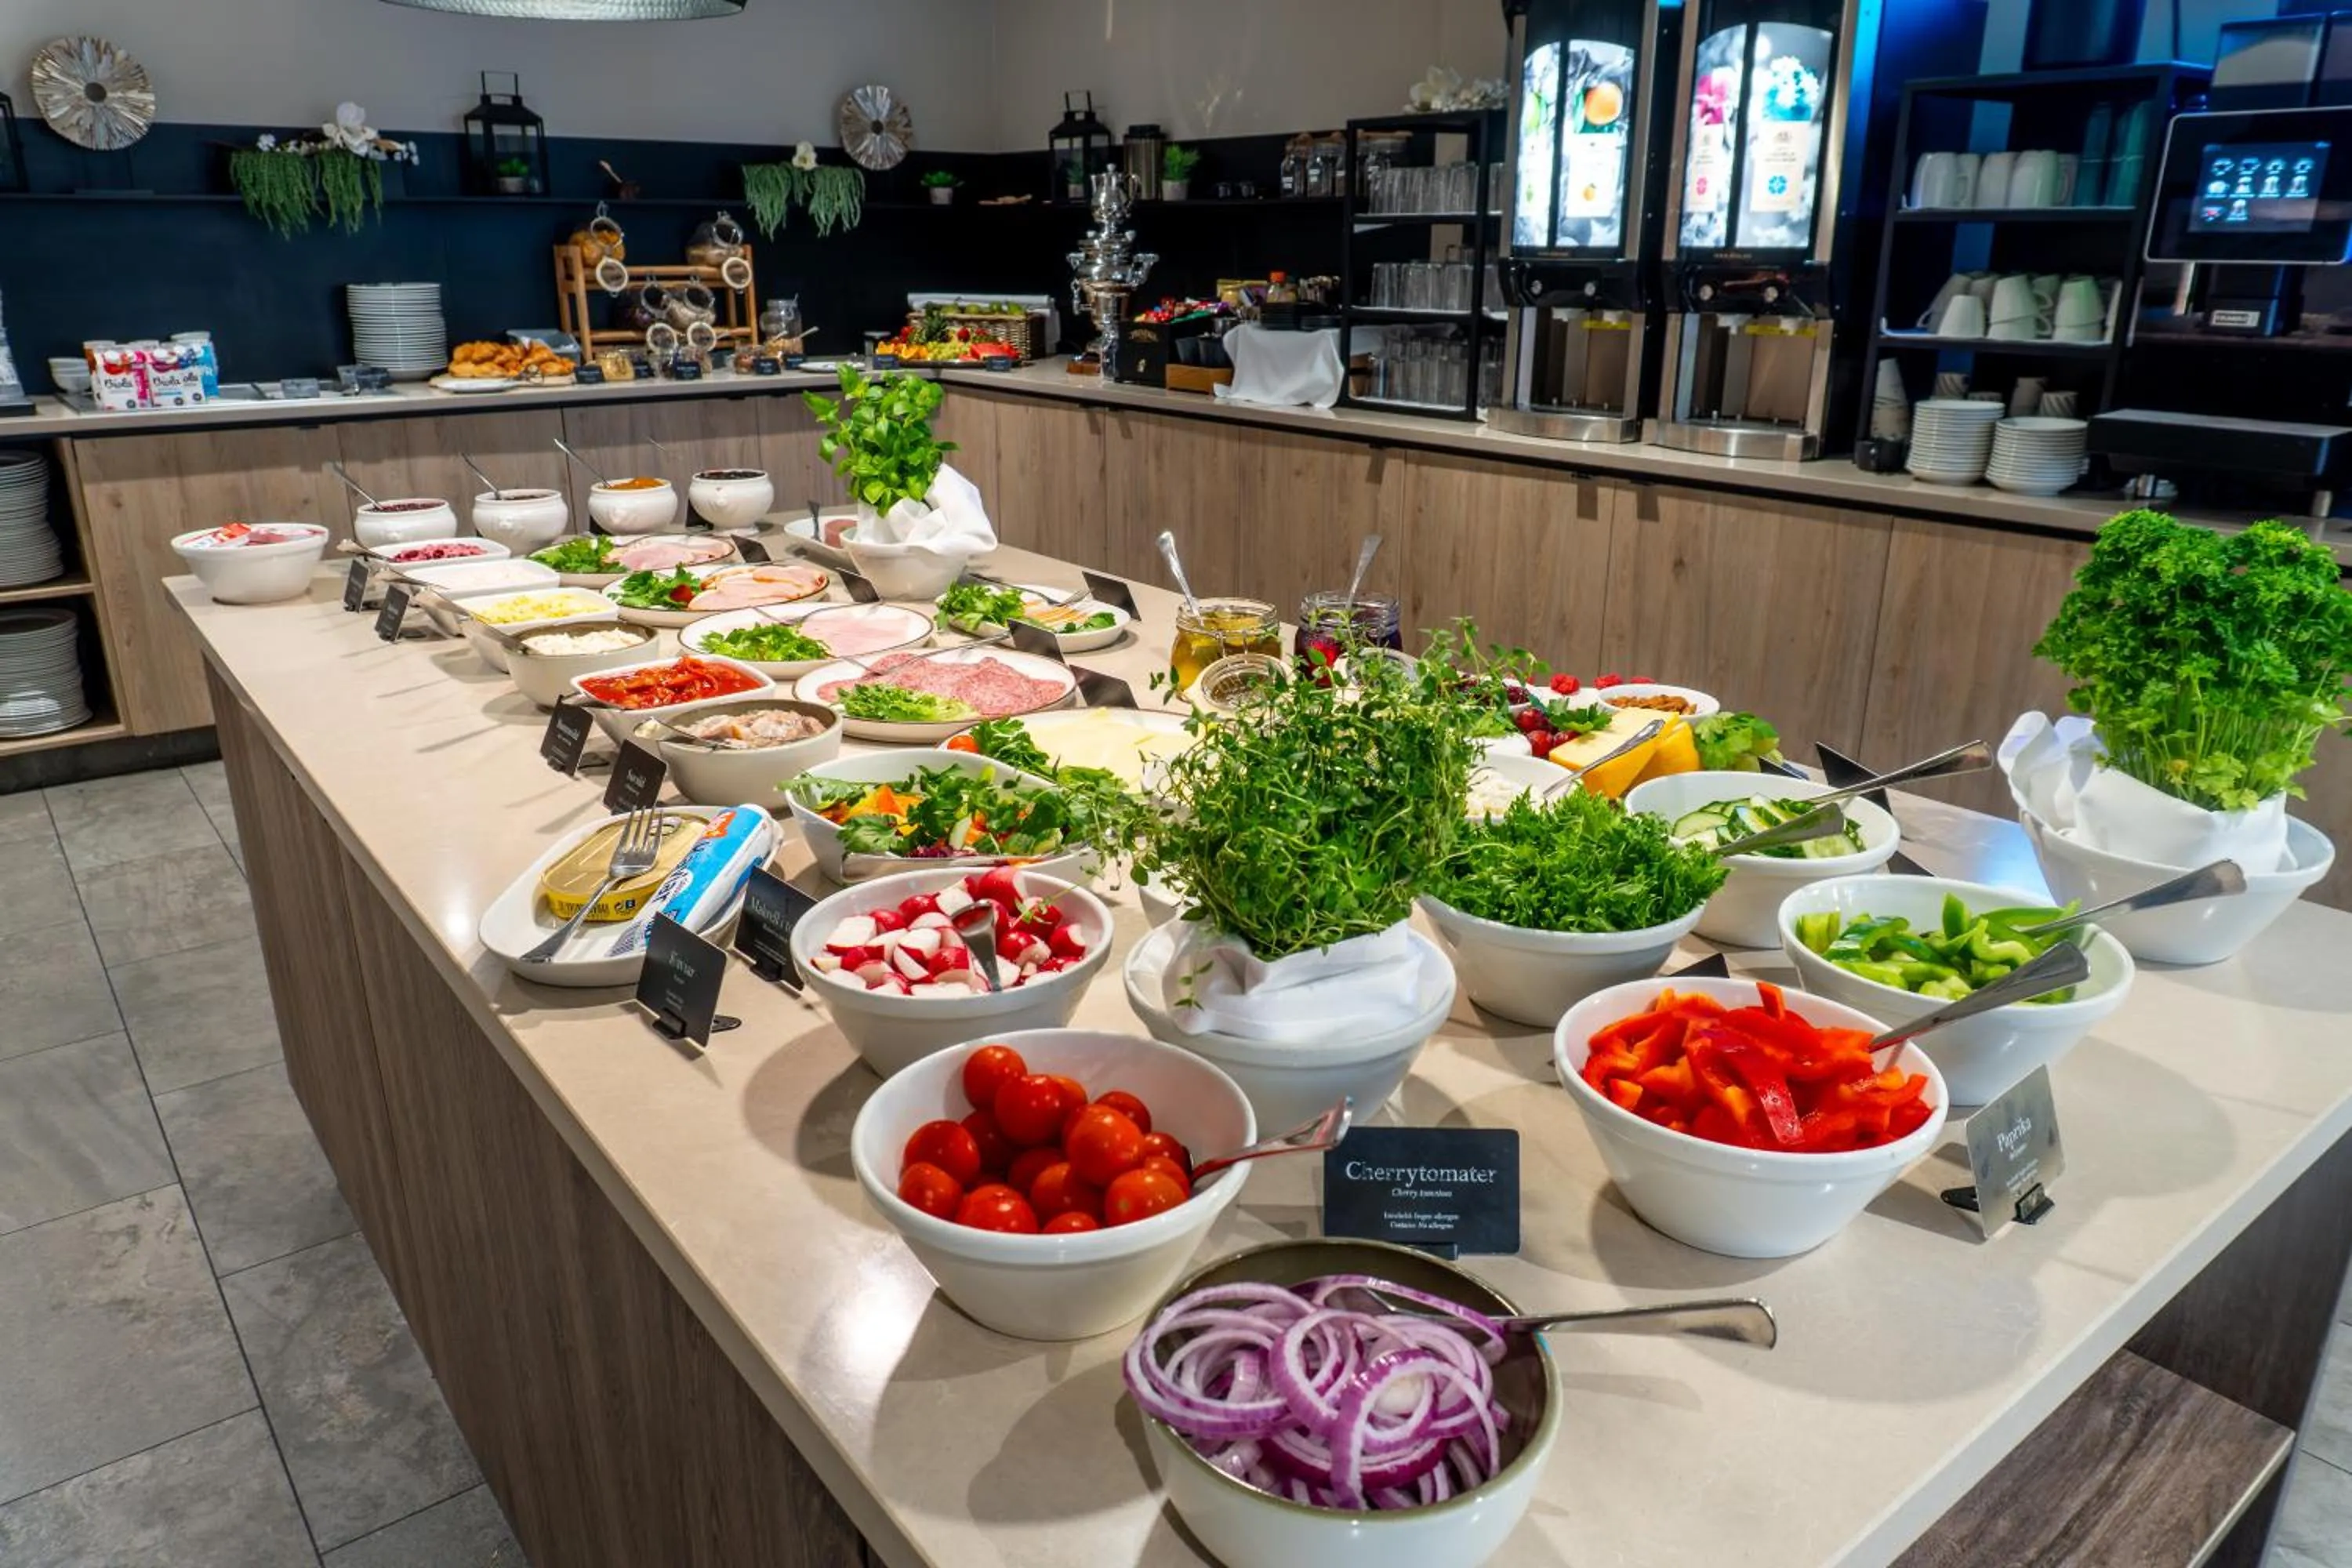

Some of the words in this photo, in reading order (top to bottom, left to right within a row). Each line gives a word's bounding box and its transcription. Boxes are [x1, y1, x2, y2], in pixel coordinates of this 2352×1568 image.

[1997, 1117, 2032, 1152] Paprika
[1345, 1161, 1497, 1187] Cherrytomater
[1392, 1188, 1417, 1200] Cherry
